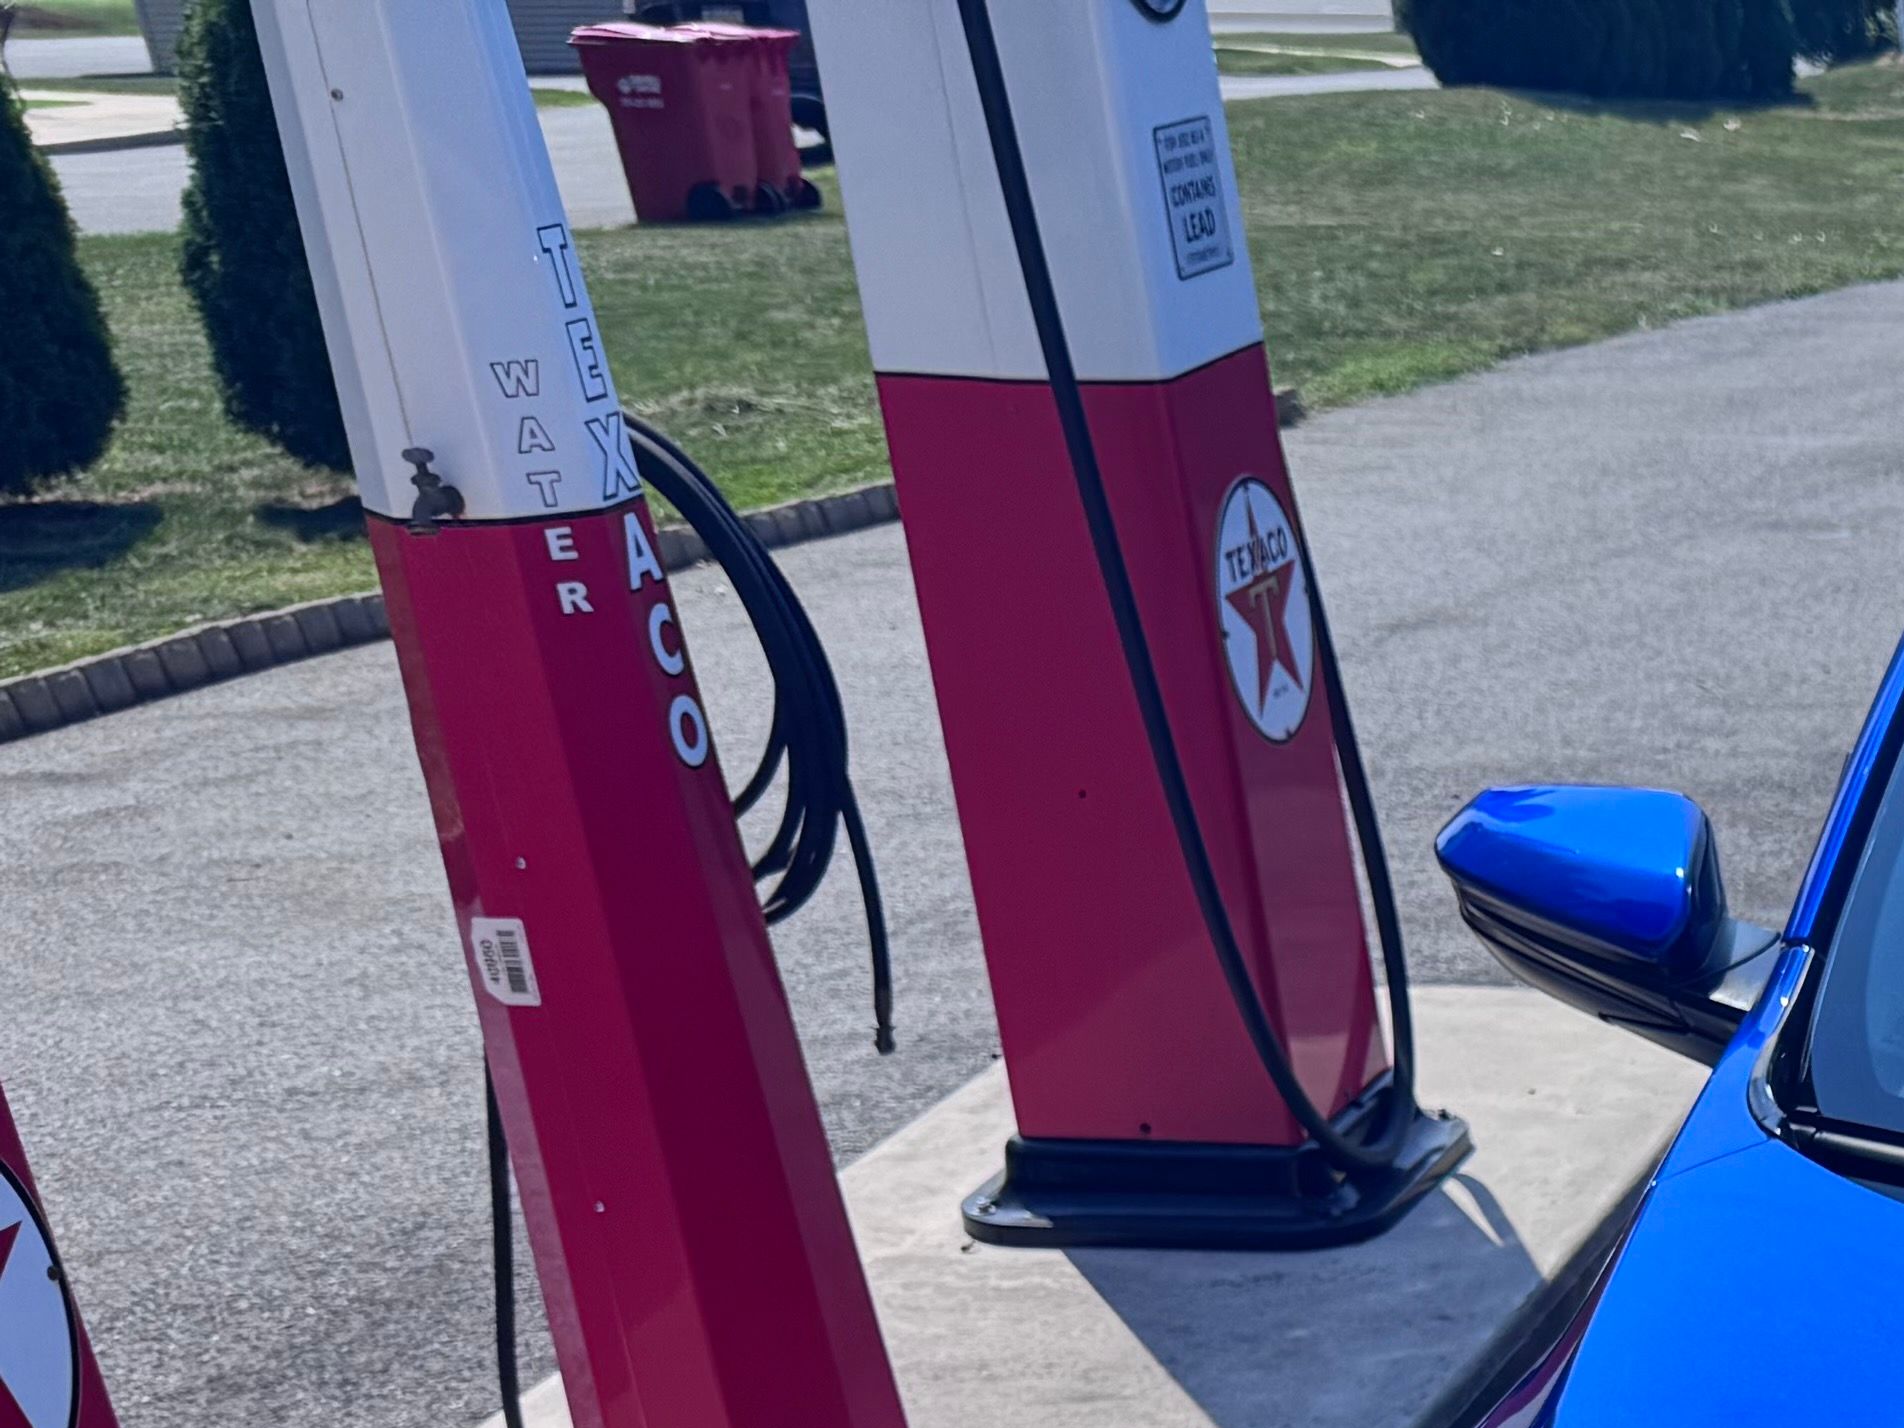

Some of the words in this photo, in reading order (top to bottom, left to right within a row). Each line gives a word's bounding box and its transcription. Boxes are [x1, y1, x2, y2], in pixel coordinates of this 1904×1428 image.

[1184, 207, 1217, 244] LEAD
[490, 358, 595, 615] WATER
[536, 222, 709, 769] TEXACO
[1225, 527, 1289, 583] TEXACO
